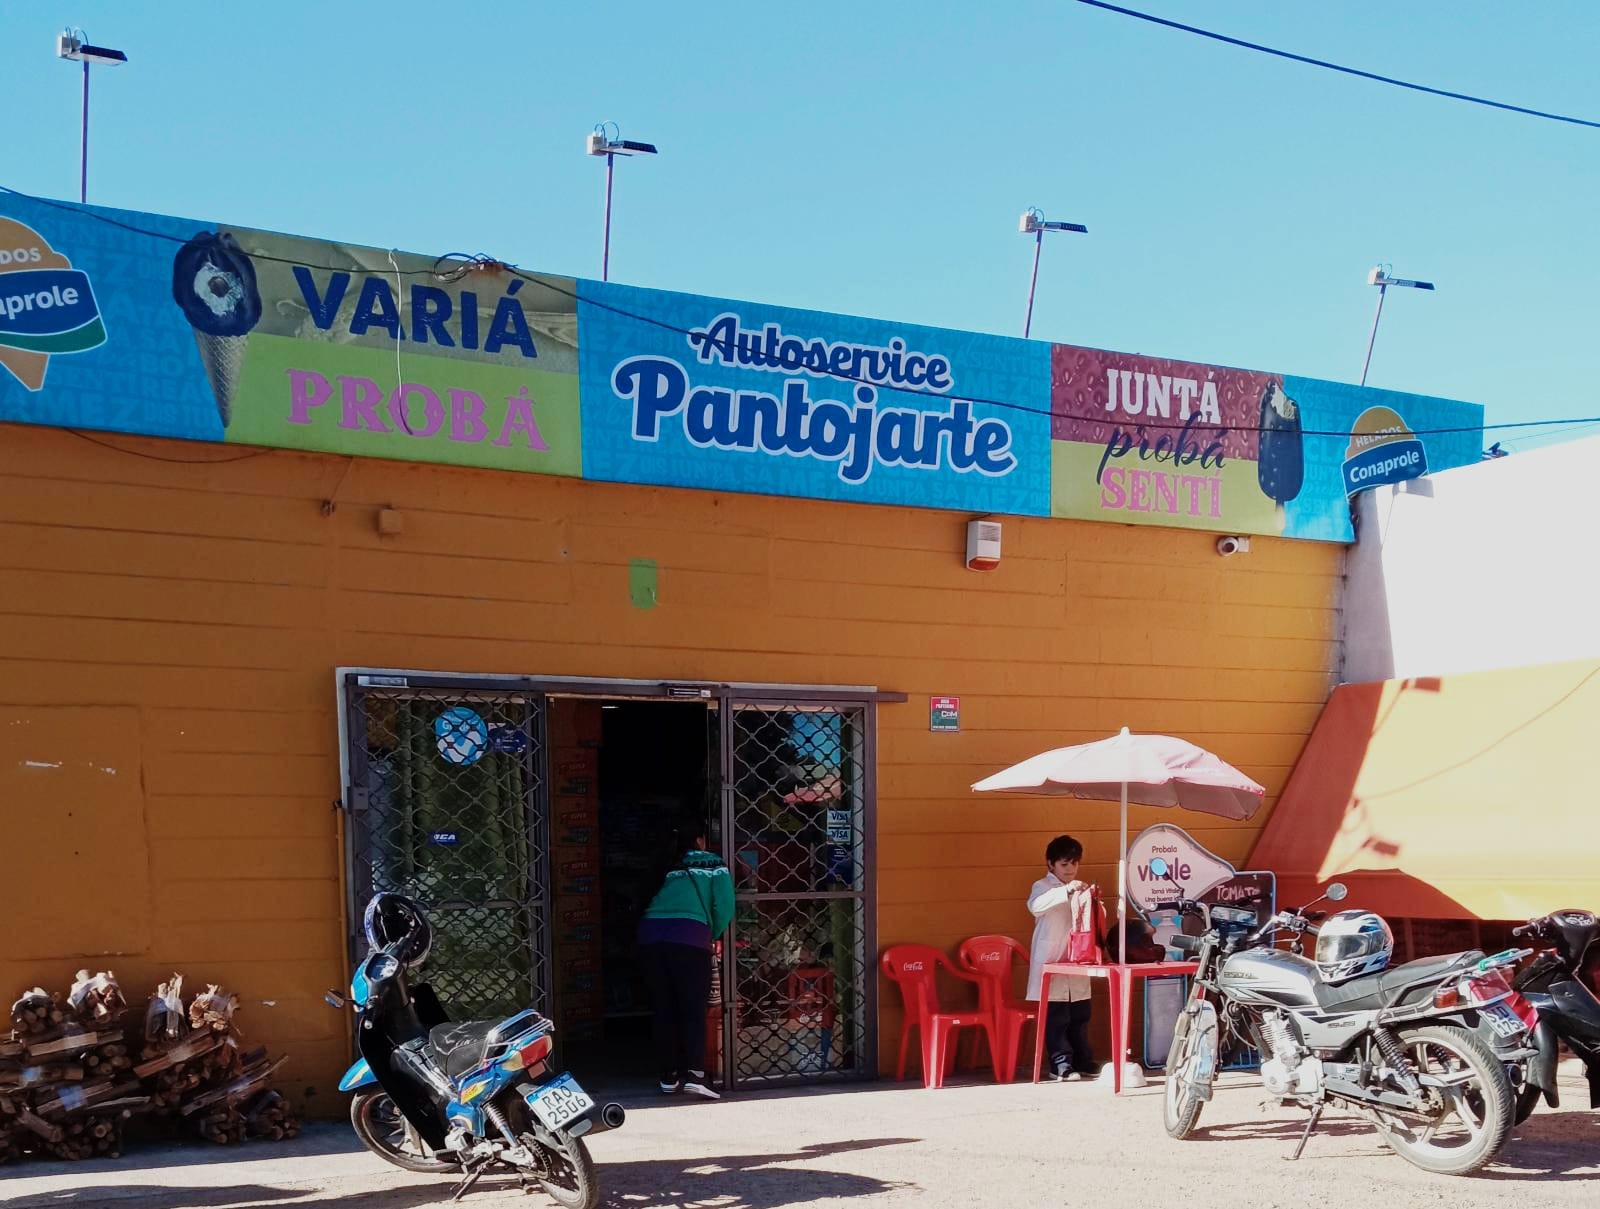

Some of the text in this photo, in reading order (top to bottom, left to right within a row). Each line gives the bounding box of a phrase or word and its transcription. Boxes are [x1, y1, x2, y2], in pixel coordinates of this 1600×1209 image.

[292, 266, 537, 358] VARIÁ
[689, 314, 951, 391] Autoservice
[285, 368, 549, 451] PROBÁ
[612, 357, 1015, 482] Pantojarte
[1105, 368, 1221, 424] JUNTÁ
[1096, 411, 1228, 485] probá
[1355, 425, 1402, 447] HELADOS
[1100, 466, 1222, 519] SENTÍ
[1350, 450, 1420, 483] Conaprole
[1137, 857, 1191, 881] vale
[1152, 844, 1177, 853] Probalo
